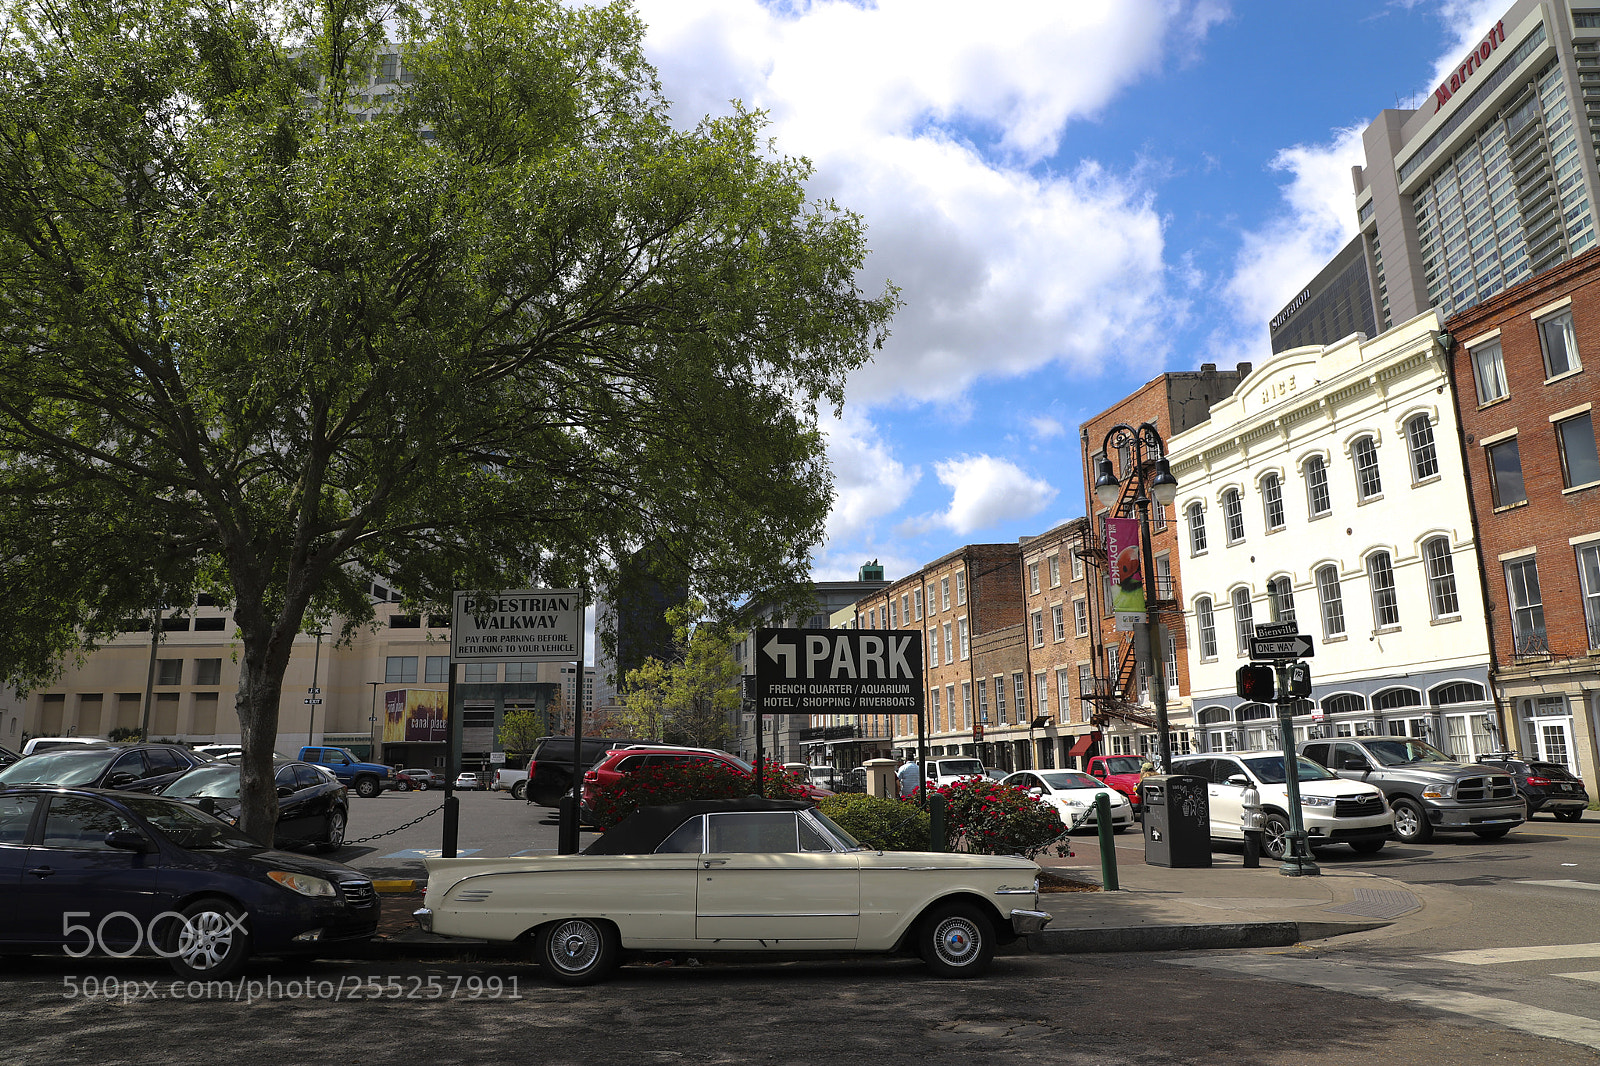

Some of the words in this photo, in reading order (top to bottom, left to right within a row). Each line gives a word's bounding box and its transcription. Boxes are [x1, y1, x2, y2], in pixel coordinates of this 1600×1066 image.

[1434, 20, 1505, 115] Marriott
[1271, 289, 1310, 331] Sheraton
[1108, 530, 1120, 585] LADYLIKE
[474, 615, 558, 629] WALKWAY
[1258, 625, 1296, 637] Bienville
[482, 635, 497, 643] FOR
[500, 635, 535, 643] PARKING
[537, 634, 568, 642] BEFORE
[541, 644, 574, 652] VEHICLE
[1257, 643, 1275, 652] ONE
[1276, 642, 1294, 651] WAY
[805, 634, 914, 678] PARK
[769, 684, 806, 694] FRENCH
[809, 684, 852, 694] QUARTER
[861, 684, 910, 694] AQUARIUM
[763, 697, 793, 707] HOTEL
[802, 697, 850, 707] SHOPPING
[859, 697, 915, 707] RIVERBOATS
[411, 713, 429, 728] canal
